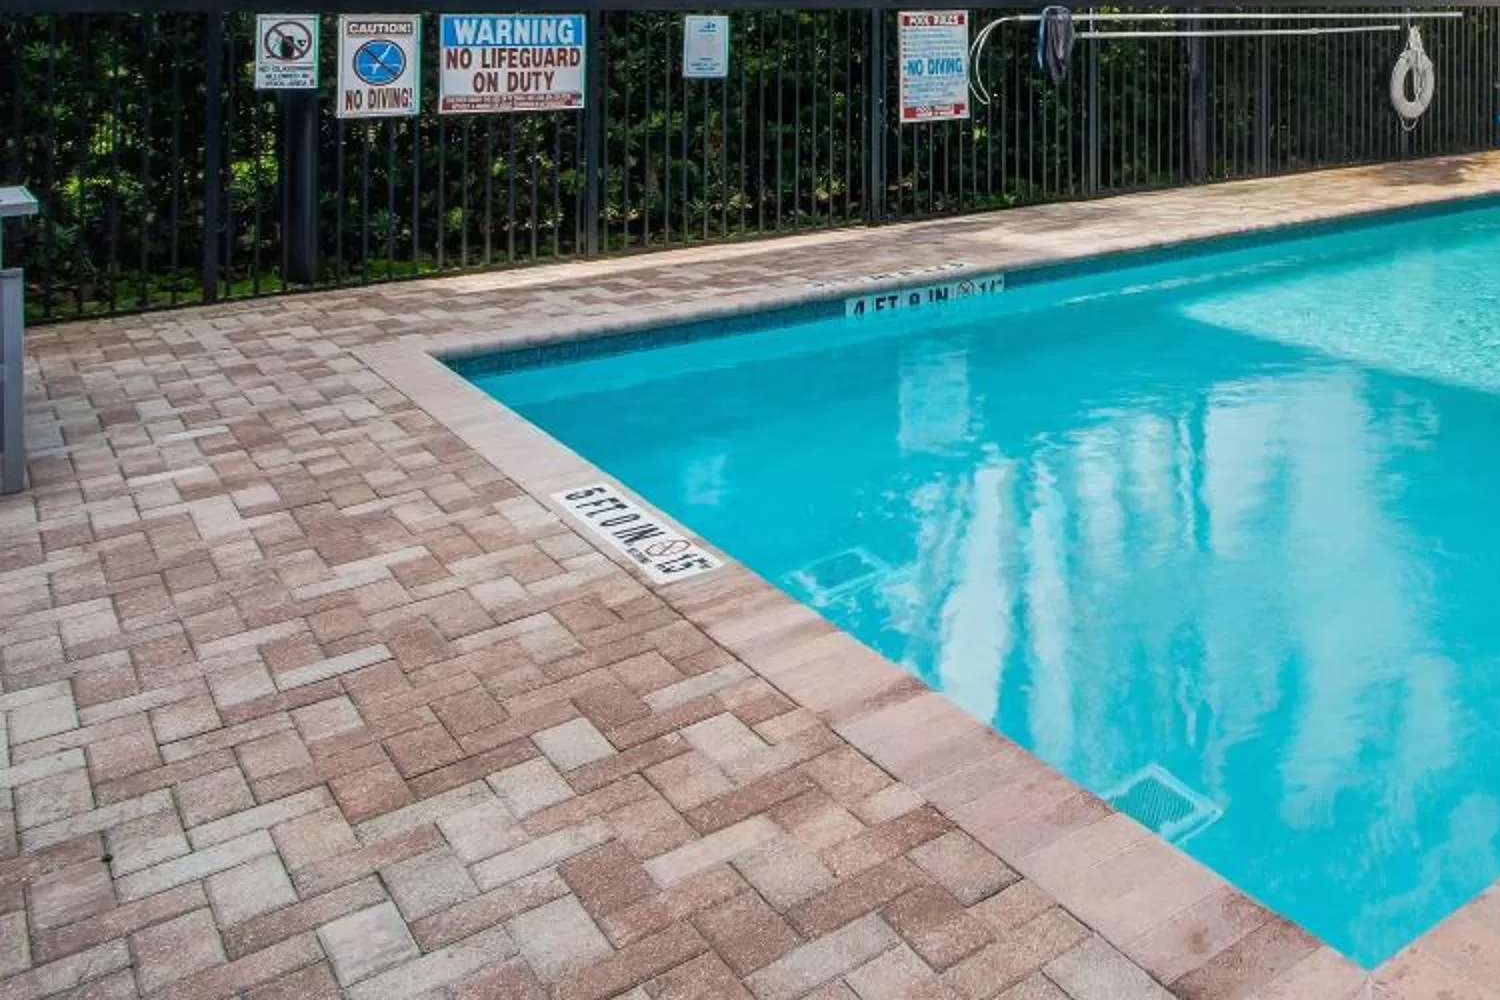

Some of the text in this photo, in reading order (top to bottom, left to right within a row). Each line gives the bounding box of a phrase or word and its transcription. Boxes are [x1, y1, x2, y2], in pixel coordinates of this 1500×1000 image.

[348, 23, 412, 33] CAUTION!
[453, 18, 575, 45] WARNING
[446, 47, 581, 70] NO LIFEGUARD
[907, 57, 963, 75] NO DIVING
[473, 71, 555, 93] ON DUTY
[345, 87, 413, 111] NO DIVING!
